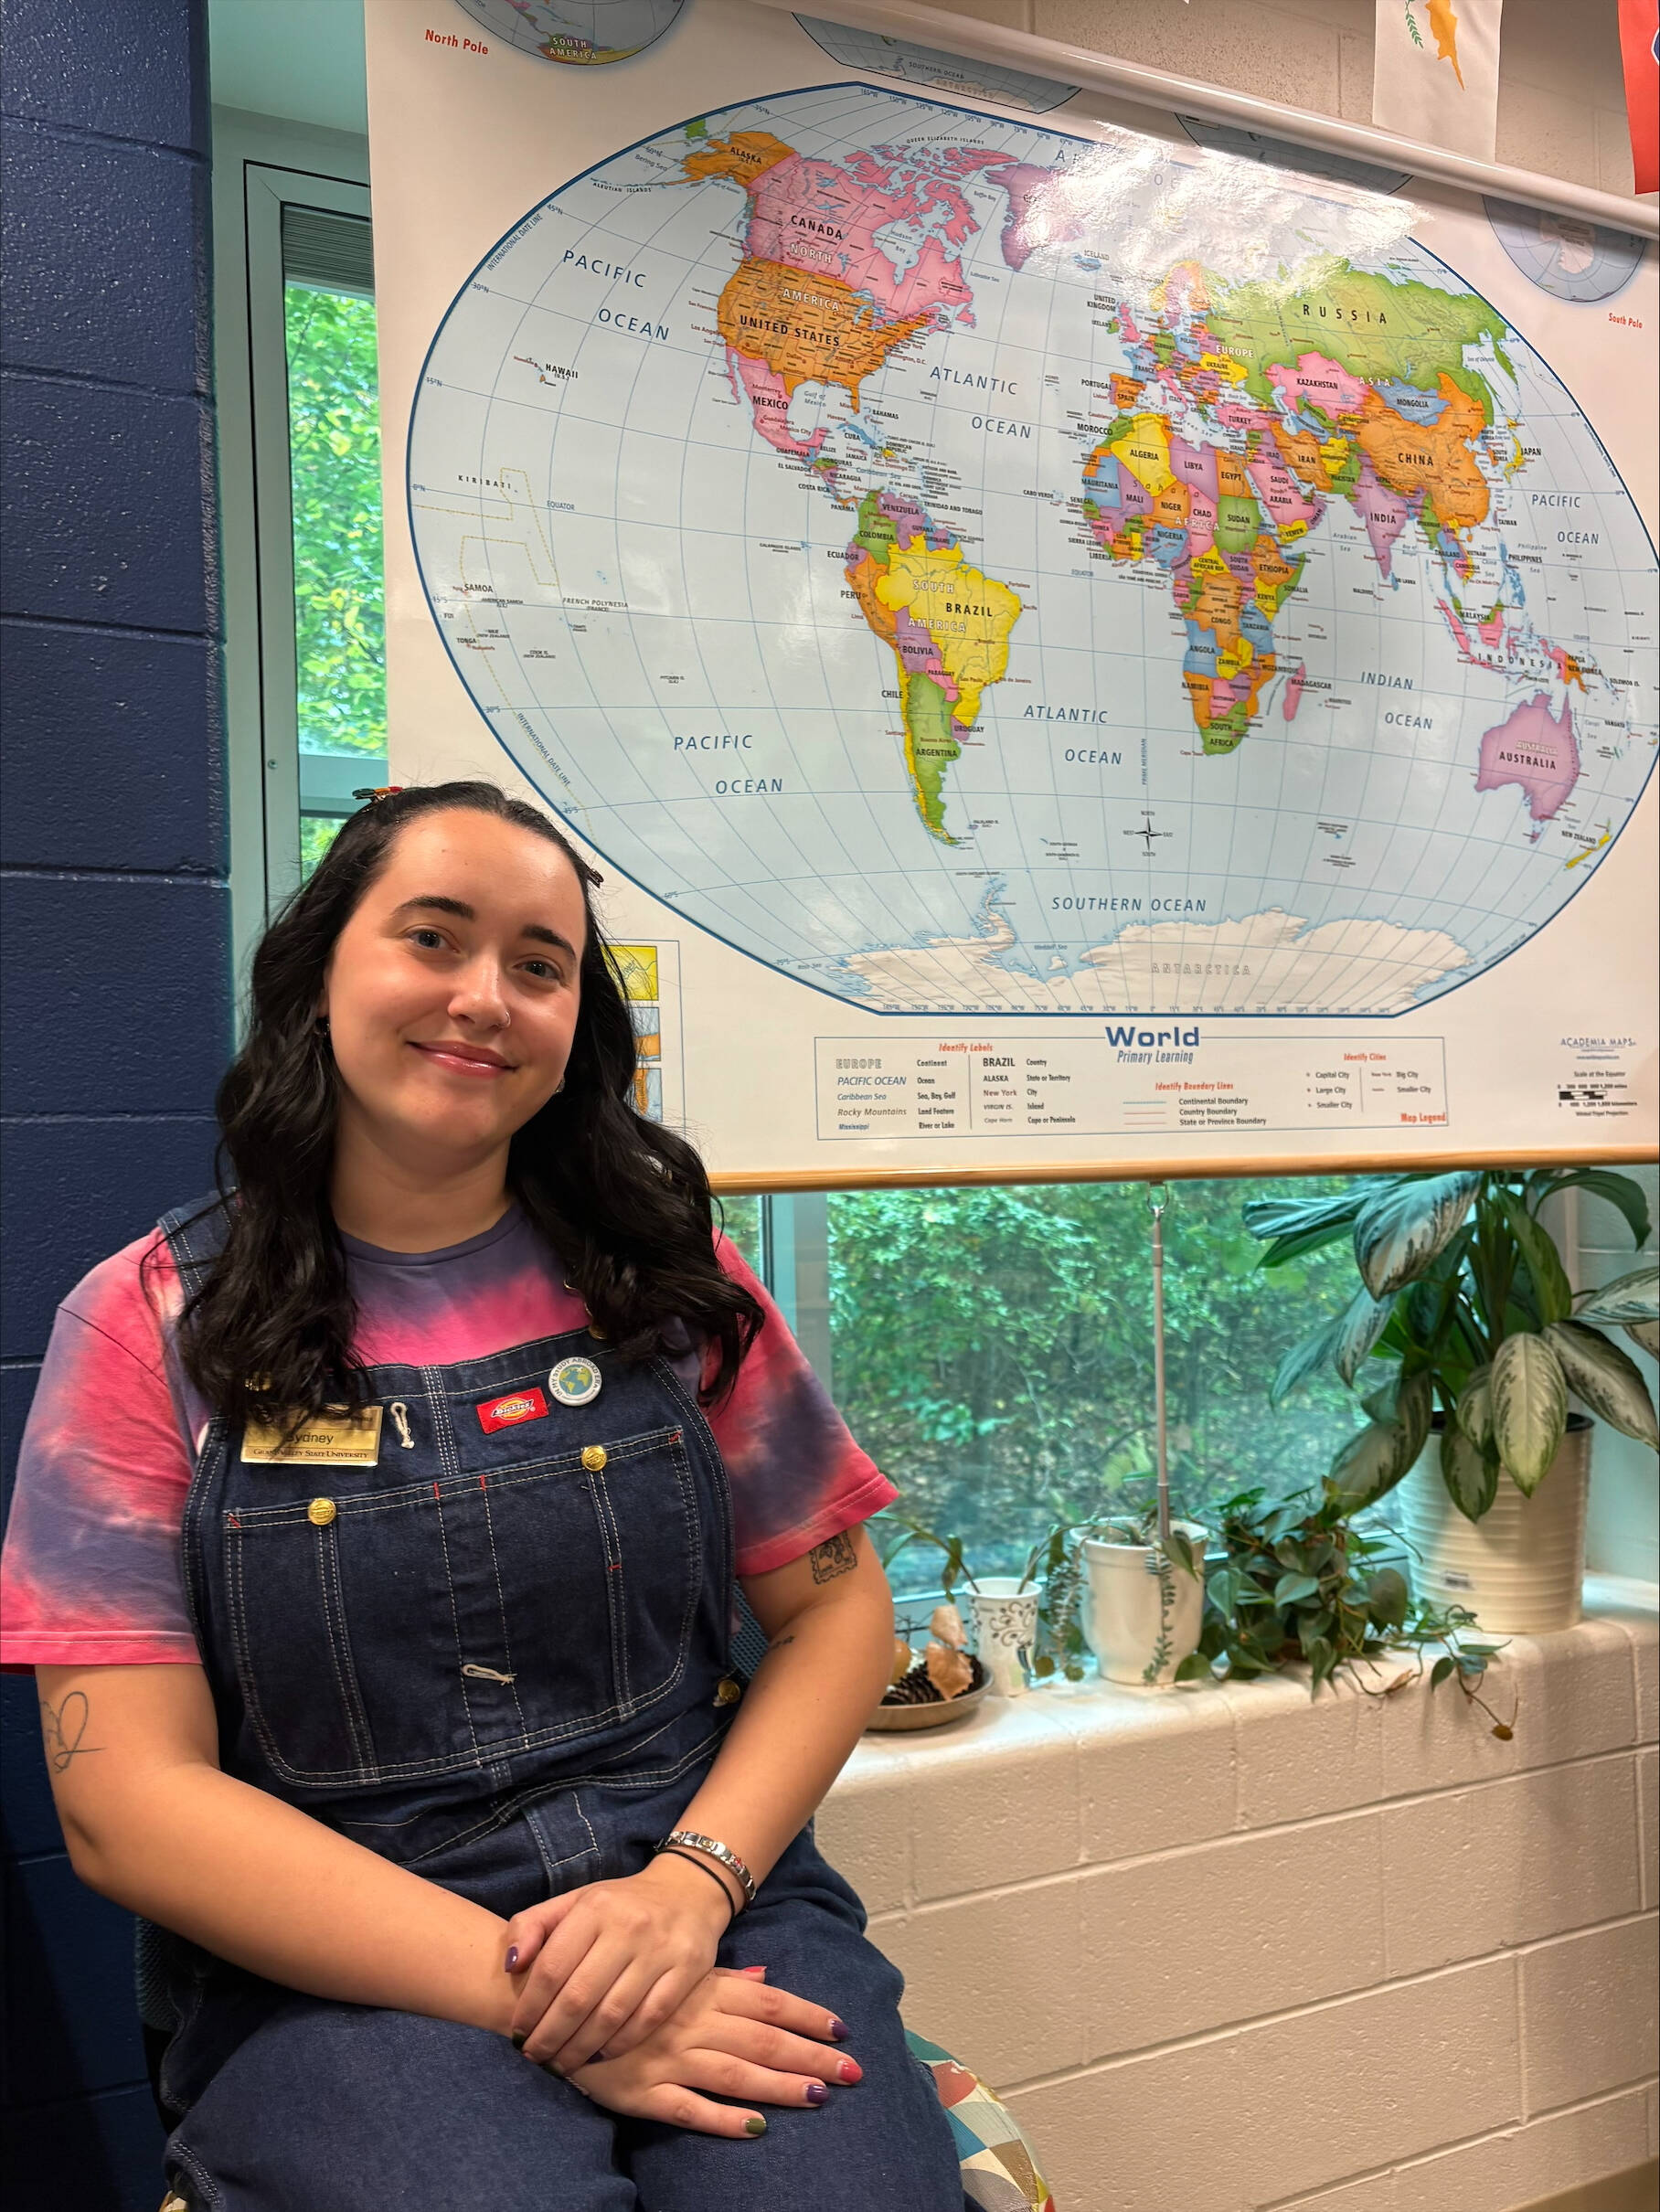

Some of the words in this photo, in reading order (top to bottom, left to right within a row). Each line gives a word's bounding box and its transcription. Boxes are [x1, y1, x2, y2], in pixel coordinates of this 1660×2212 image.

[424, 28, 459, 48] North
[463, 37, 489, 55] Pole
[552, 36, 587, 48] SOUTH
[549, 47, 597, 59] AMERICA
[730, 146, 762, 165] ALASKA
[791, 214, 844, 239] CANADA
[486, 235, 521, 271] INTERNATIONAL
[518, 223, 532, 236] DATE
[530, 213, 543, 226] LINE
[790, 243, 833, 264] NORTH
[562, 250, 647, 288] PACIFIC
[782, 289, 839, 311] AMERICA
[1094, 294, 1115, 304] UNITED
[1087, 301, 1116, 312] KINGDOM
[1303, 303, 1387, 324] RUSSIA
[598, 309, 670, 340] OCEAN
[1609, 313, 1626, 324] South
[1628, 318, 1643, 329] Pole
[740, 315, 788, 335] UNITED
[794, 327, 840, 346] STATES
[1216, 345, 1253, 358] EUROPE
[546, 364, 579, 379] HAWAII
[930, 367, 1017, 395] ATLANTIC
[1081, 379, 1112, 390] PORTUGAL
[1296, 378, 1338, 389] KAZAKHSTAN
[1359, 377, 1391, 387] ASIA
[752, 396, 789, 410] MEXICO
[1397, 398, 1429, 409] MONGOLIA
[1229, 416, 1251, 426] TURKEY
[972, 416, 1031, 439] OCEAN
[1077, 423, 1112, 435] MOROCCO
[845, 432, 861, 441] CUBA
[1130, 449, 1159, 461] ALGERIA
[1521, 447, 1541, 456] JAPAN
[1298, 454, 1316, 464] IRAN
[1398, 452, 1433, 466] CHINA
[1184, 461, 1203, 471] LIBYA
[458, 474, 512, 490] KIRIBATI
[1221, 472, 1241, 481] EGYPT
[1271, 475, 1289, 484] SAUDI
[1126, 494, 1144, 503] MALI
[1270, 495, 1293, 505] ARABIA
[1532, 494, 1580, 507] PACIFIC
[882, 504, 920, 516] VENEZUELA
[1161, 502, 1181, 511] NIGER
[1193, 508, 1212, 517] CHAD
[1227, 514, 1250, 524] SUDAN
[1371, 514, 1396, 525] INDIA
[859, 530, 894, 541] COLOMBIA
[1157, 530, 1183, 541] NIGERIA
[1557, 531, 1600, 544] OCEAN
[827, 550, 859, 560] ECUADOR
[1508, 553, 1543, 563] PHILIPPINES
[1260, 563, 1289, 574] ETHIOPIA
[464, 583, 494, 594] SAMOA
[913, 580, 954, 593] SOUTH
[840, 590, 862, 600] PERU
[946, 602, 993, 617] BRAZIL
[908, 618, 966, 632] AMERICA
[902, 645, 933, 655] BOLIVIA
[1189, 644, 1216, 654] ANGOLA
[1478, 654, 1562, 671] INDONESIA
[1291, 678, 1332, 689] MADAGASCAR
[1361, 671, 1413, 689] INDIAN
[881, 690, 903, 699] CHILE
[1025, 705, 1108, 724] ATLANTIC
[1385, 712, 1432, 729] OCEAN
[674, 735, 753, 750] PACIFIC
[916, 748, 958, 758] ARGENTINA
[1065, 749, 1123, 765] OCEAN
[1499, 751, 1556, 770] AUSTRALIA
[715, 779, 783, 794] OCEAN
[1051, 897, 1142, 912] SOUTHERN
[1151, 898, 1208, 912] OCEAN
[1152, 962, 1250, 976] ANTARCTICA
[1105, 1026, 1199, 1048] World
[1560, 1037, 1606, 1047] ACADEMIA
[938, 1043, 968, 1053] Identify
[983, 1058, 1016, 1067] BRAZIL
[1027, 1058, 1047, 1067] Country
[1117, 1050, 1153, 1064] Primary
[1155, 1050, 1194, 1064] Learning
[1344, 1053, 1368, 1061] Identify
[835, 1058, 882, 1069] EUROPE
[1315, 1071, 1334, 1079] Capital
[1335, 1071, 1349, 1079] City
[837, 1077, 871, 1085] PACIFIC
[875, 1077, 907, 1085] OCEAN
[1155, 1082, 1181, 1091] Identify
[837, 1093, 872, 1101] Caribbean
[1000, 1089, 1016, 1097] York
[1027, 1089, 1038, 1097] City
[837, 1108, 861, 1117] Rocky
[864, 1108, 907, 1116] Mountains
[1179, 1108, 1205, 1117] Country
[1207, 1108, 1237, 1116] Boundary
[1400, 1113, 1417, 1122] Map
[1420, 1113, 1446, 1123] Legend
[553, 1360, 569, 1377] STUDY
[551, 1378, 557, 1388] MY
[493, 1400, 532, 1416] Dickies
[326, 1450, 367, 1458] UNIVERSITY
